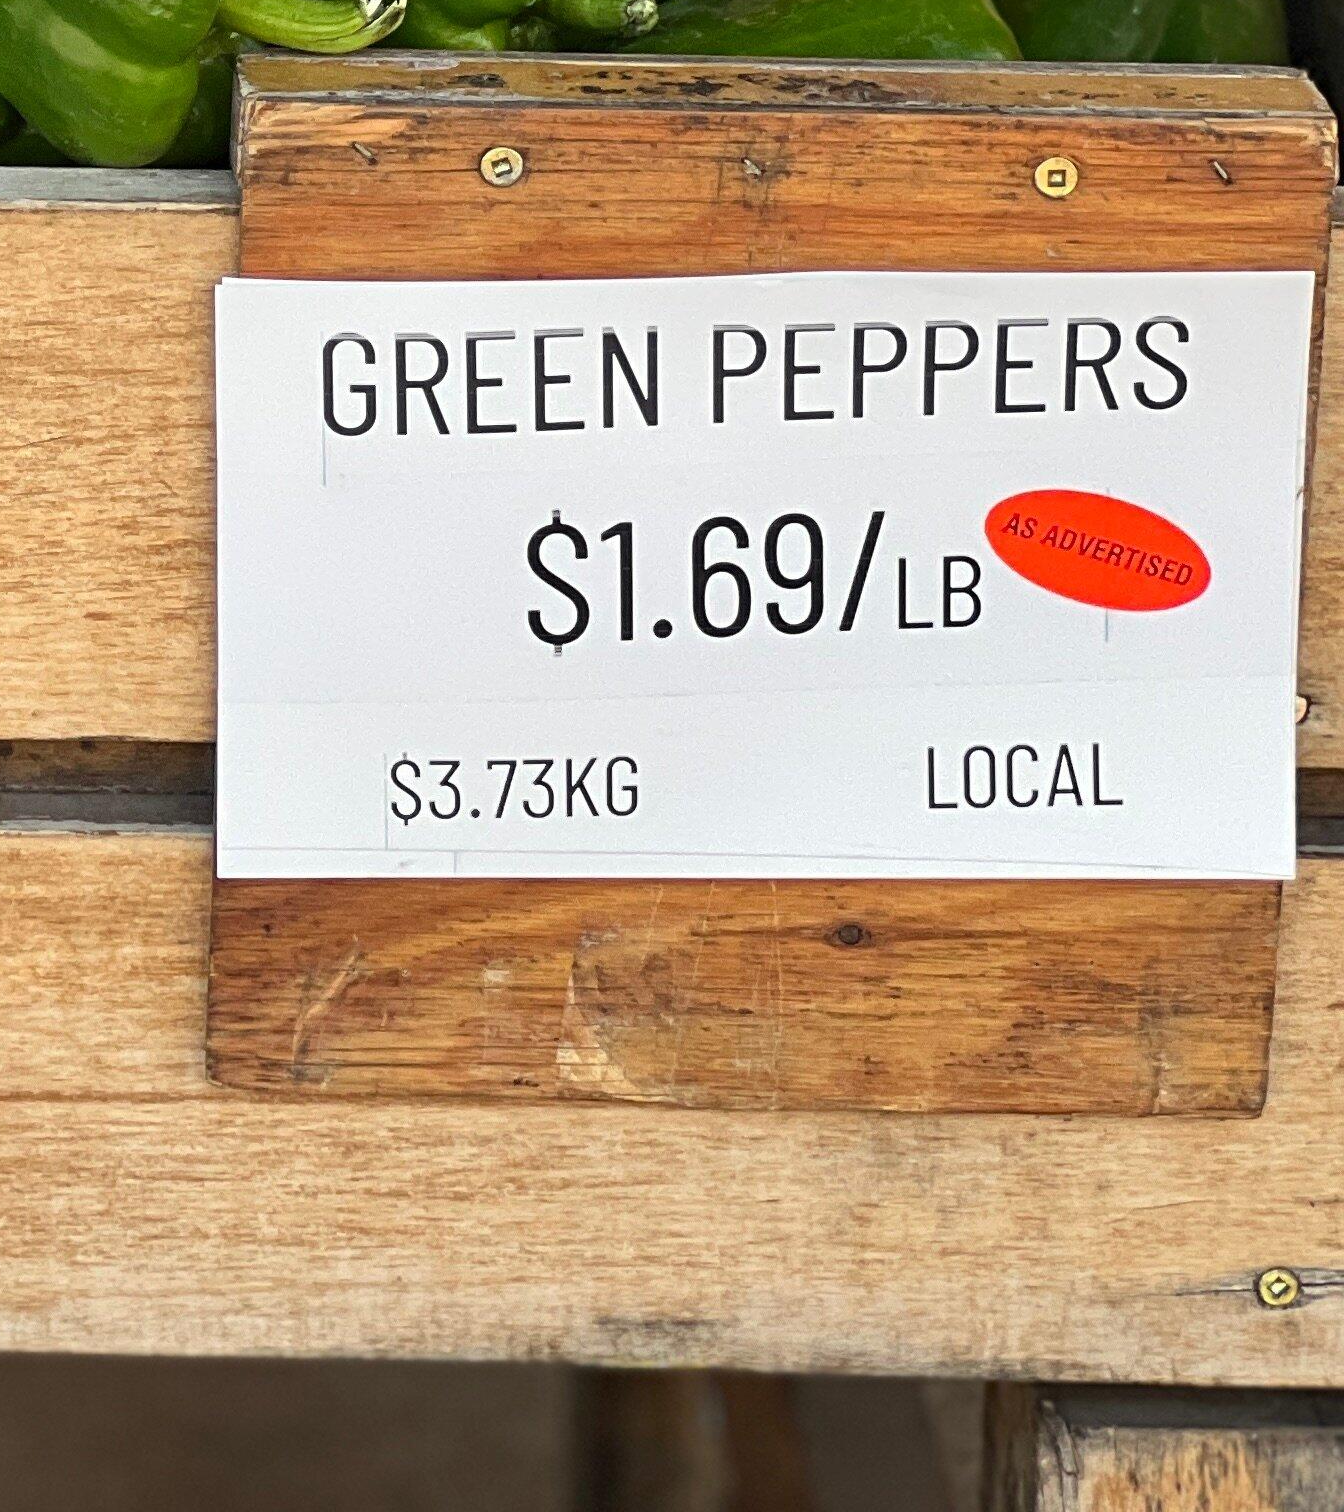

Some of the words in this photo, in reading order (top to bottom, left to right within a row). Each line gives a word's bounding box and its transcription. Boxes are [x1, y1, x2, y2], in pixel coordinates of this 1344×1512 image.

[321, 326, 660, 437] GREEN
[711, 317, 1189, 424] PEPPERS
[526, 509, 983, 656] $1.69/LB
[1001, 512, 1039, 540] AS
[1040, 524, 1194, 587] ADVERTISED
[389, 755, 639, 826] $3.73KG
[926, 743, 1124, 810] LOCAL
